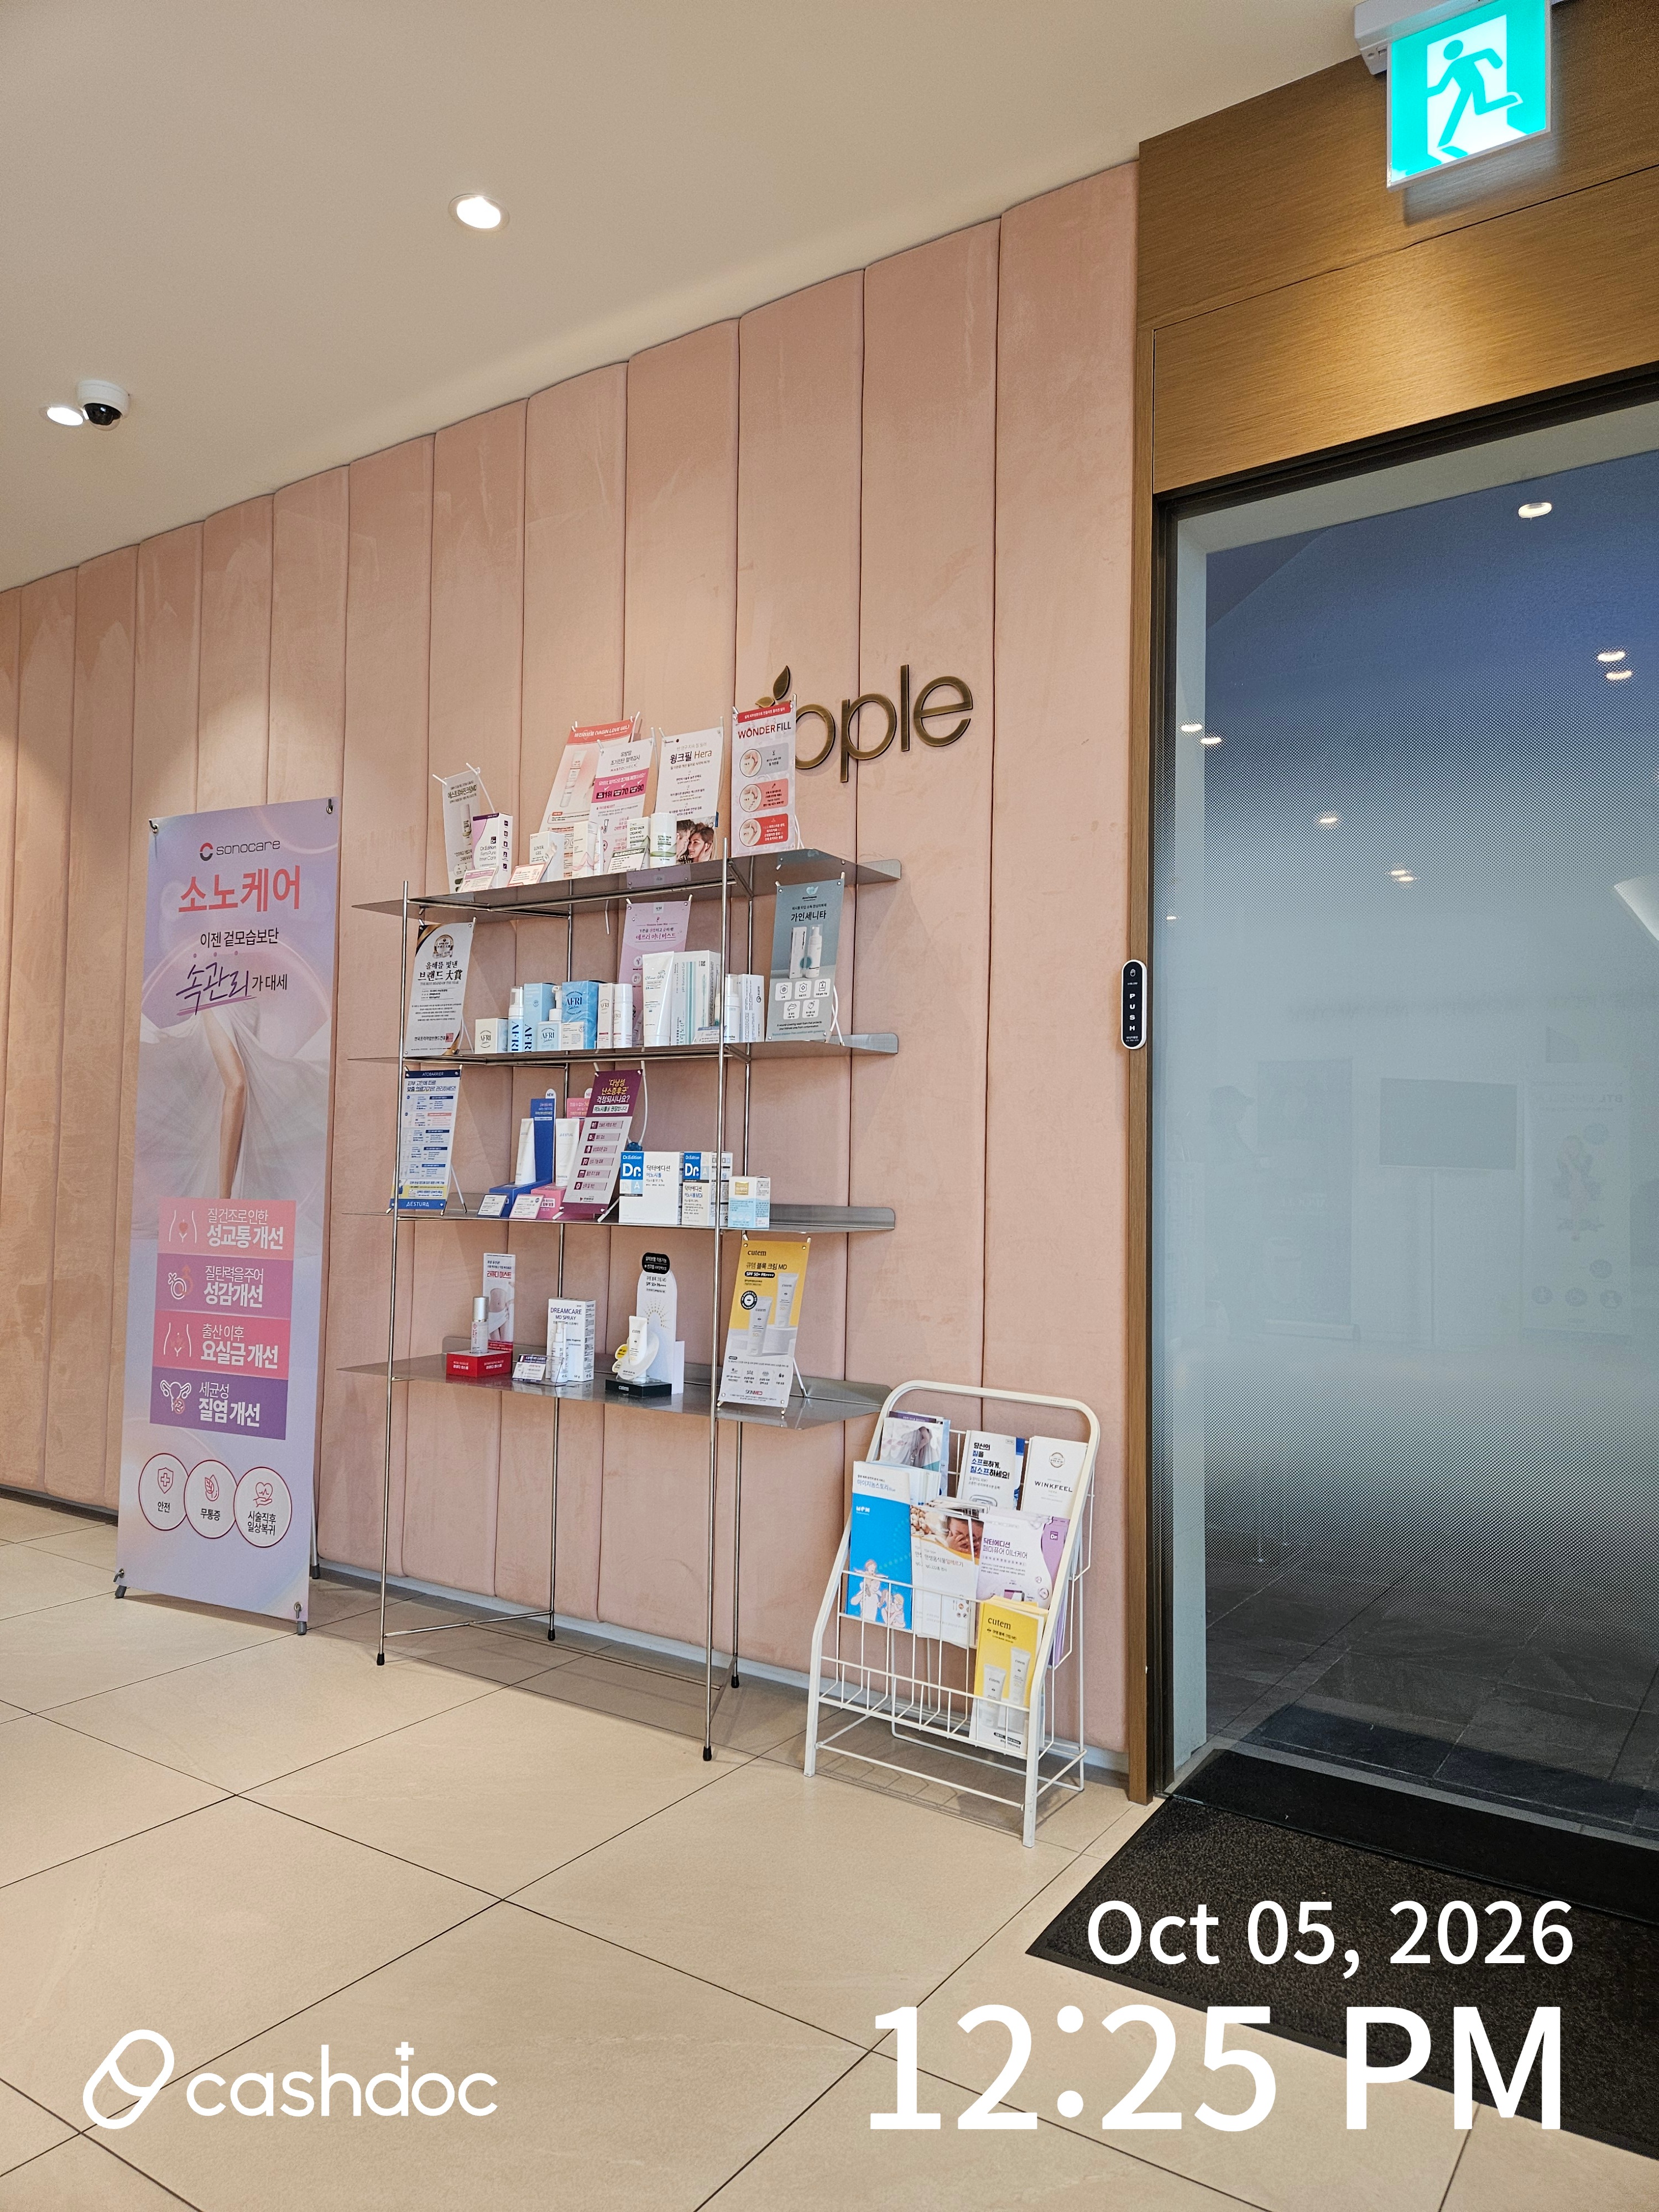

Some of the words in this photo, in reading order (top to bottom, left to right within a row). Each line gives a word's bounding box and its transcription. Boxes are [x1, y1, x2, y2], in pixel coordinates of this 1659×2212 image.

[738, 724, 775, 739] WONDER
[776, 722, 791, 732] FILL
[670, 751, 692, 764] 윙크필
[694, 750, 712, 759] Hera
[216, 839, 281, 856] sonocare
[178, 865, 301, 913] 소노케어
[790, 910, 827, 922] 가인세니타
[200, 932, 221, 948] 이젠
[223, 927, 279, 947] 겉모습보단
[425, 961, 444, 970] 올해를
[265, 974, 288, 990] 대세
[418, 971, 444, 982] 브랜드
[445, 969, 463, 980] 大賞
[566, 997, 582, 1006] AFRI
[597, 1095, 630, 1104] 걱정되시나요?
[622, 1163, 641, 1177] Dr.
[685, 1163, 699, 1177] Dr.
[207, 1224, 251, 1249] 성교통
[253, 1226, 284, 1250] 개선
[202, 1323, 222, 1340] 출산
[224, 1325, 244, 1342] 이후
[201, 1340, 246, 1366] 요실금
[247, 1344, 278, 1369] 개선
[200, 1381, 229, 1399] 세균성
[199, 1398, 228, 1423] 질염
[229, 1401, 260, 1428] 개선
[974, 1442, 990, 1451] 당신의
[970, 1466, 1010, 1479] 질소프하세요!
[857, 1479, 889, 1491] 마이지놈스토리
[1034, 1480, 1073, 1493] WINKFEEL
[158, 1501, 170, 1513] 안전
[200, 1508, 221, 1521] 무통증
[248, 1511, 276, 1523] 시술직후
[247, 1521, 275, 1536] 일상복귀
[983, 1538, 1010, 1548] 닥터에디션
[1005, 1550, 1028, 1559] 이너케어
[988, 1618, 1011, 1630] cutem
